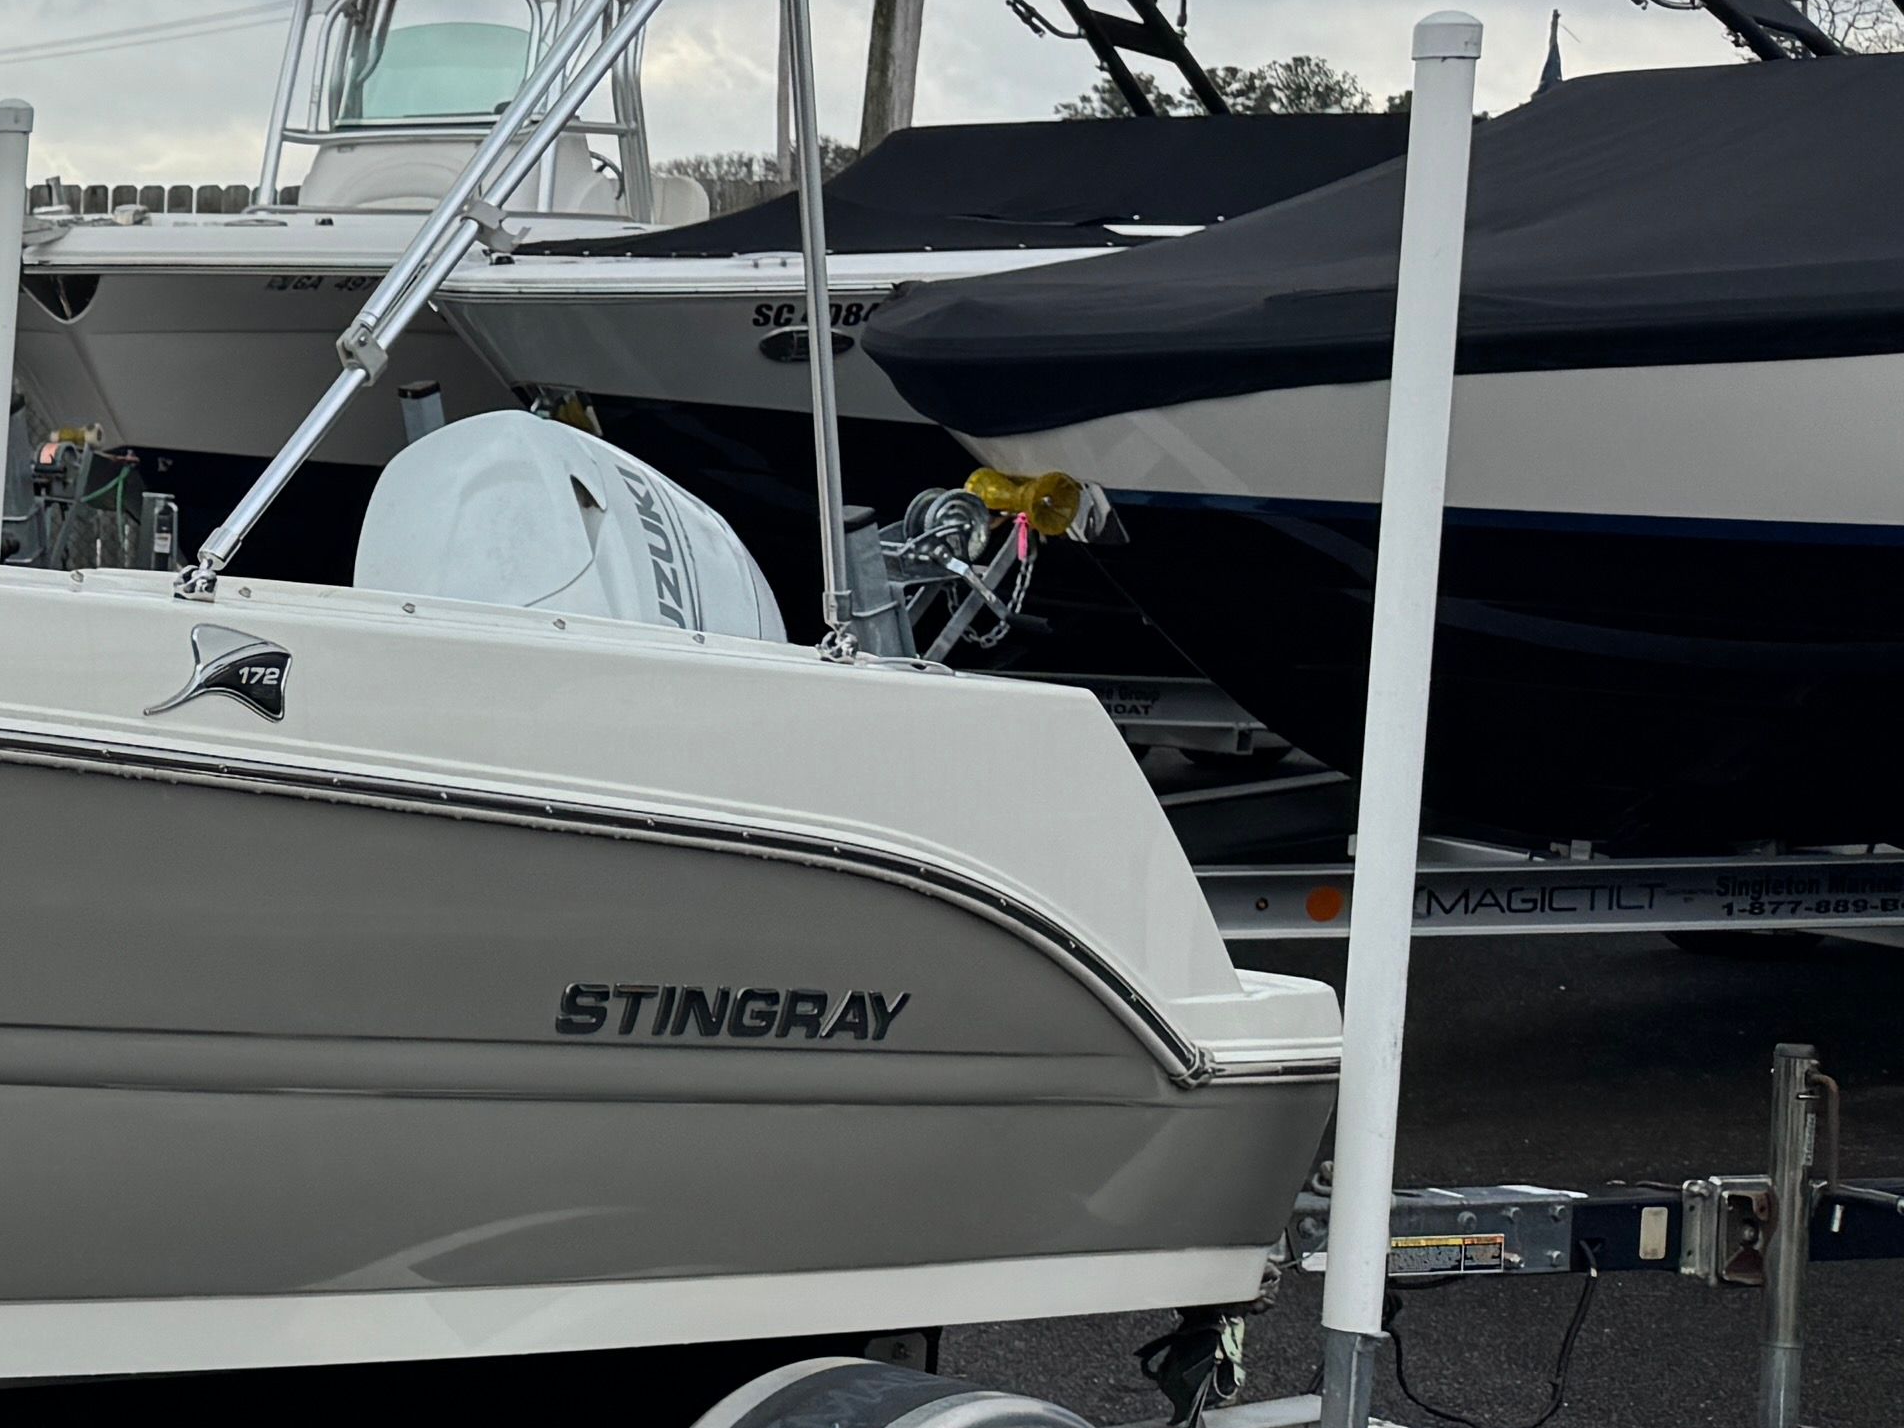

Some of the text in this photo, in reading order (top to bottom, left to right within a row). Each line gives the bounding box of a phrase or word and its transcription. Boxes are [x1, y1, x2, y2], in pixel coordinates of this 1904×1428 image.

[752, 303, 796, 327] SC
[239, 667, 280, 684] 172
[1426, 883, 1665, 914] MAGICTILT
[1714, 875, 1820, 901] Singleton
[555, 983, 911, 1040] STINGRAY
